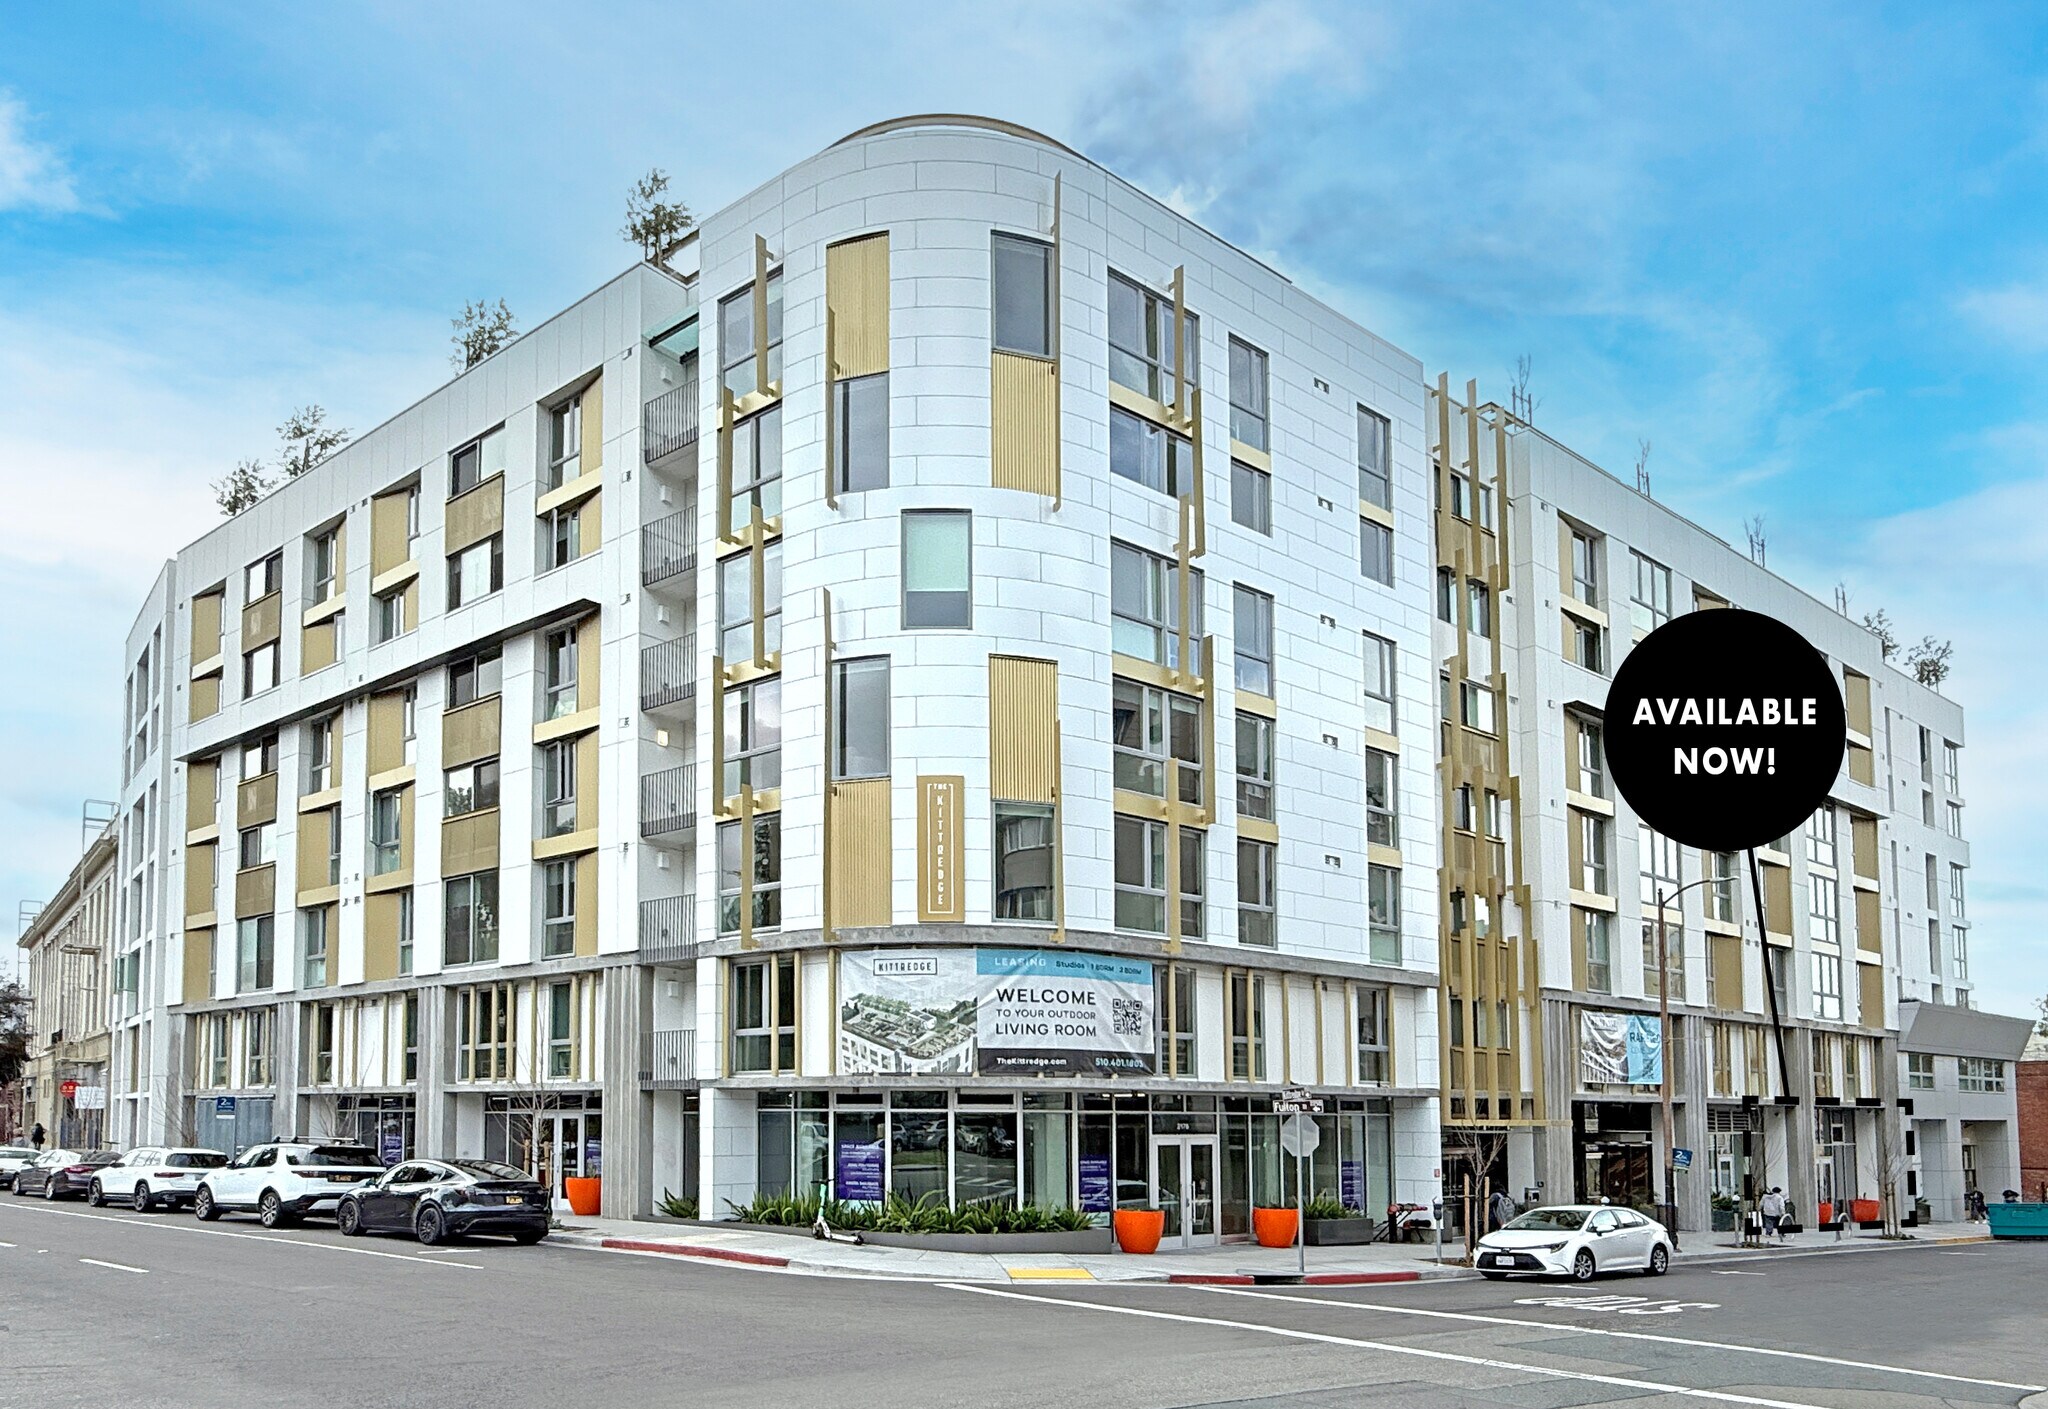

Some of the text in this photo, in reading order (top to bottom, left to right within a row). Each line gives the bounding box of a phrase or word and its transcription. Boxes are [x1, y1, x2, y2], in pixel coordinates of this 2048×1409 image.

[936, 795, 945, 905] KITTREDGE
[878, 962, 932, 971] KITTREDGE
[994, 957, 1046, 967] LEASING
[1055, 961, 1085, 969] Studios
[996, 988, 1096, 1005] WELCOME
[996, 1009, 1096, 1020] TO YOUR OUTDOOR
[996, 1023, 1097, 1037] LIVING ROOM
[996, 1057, 1067, 1067] TheKittredge.com
[1274, 1101, 1300, 1112] Fulton
